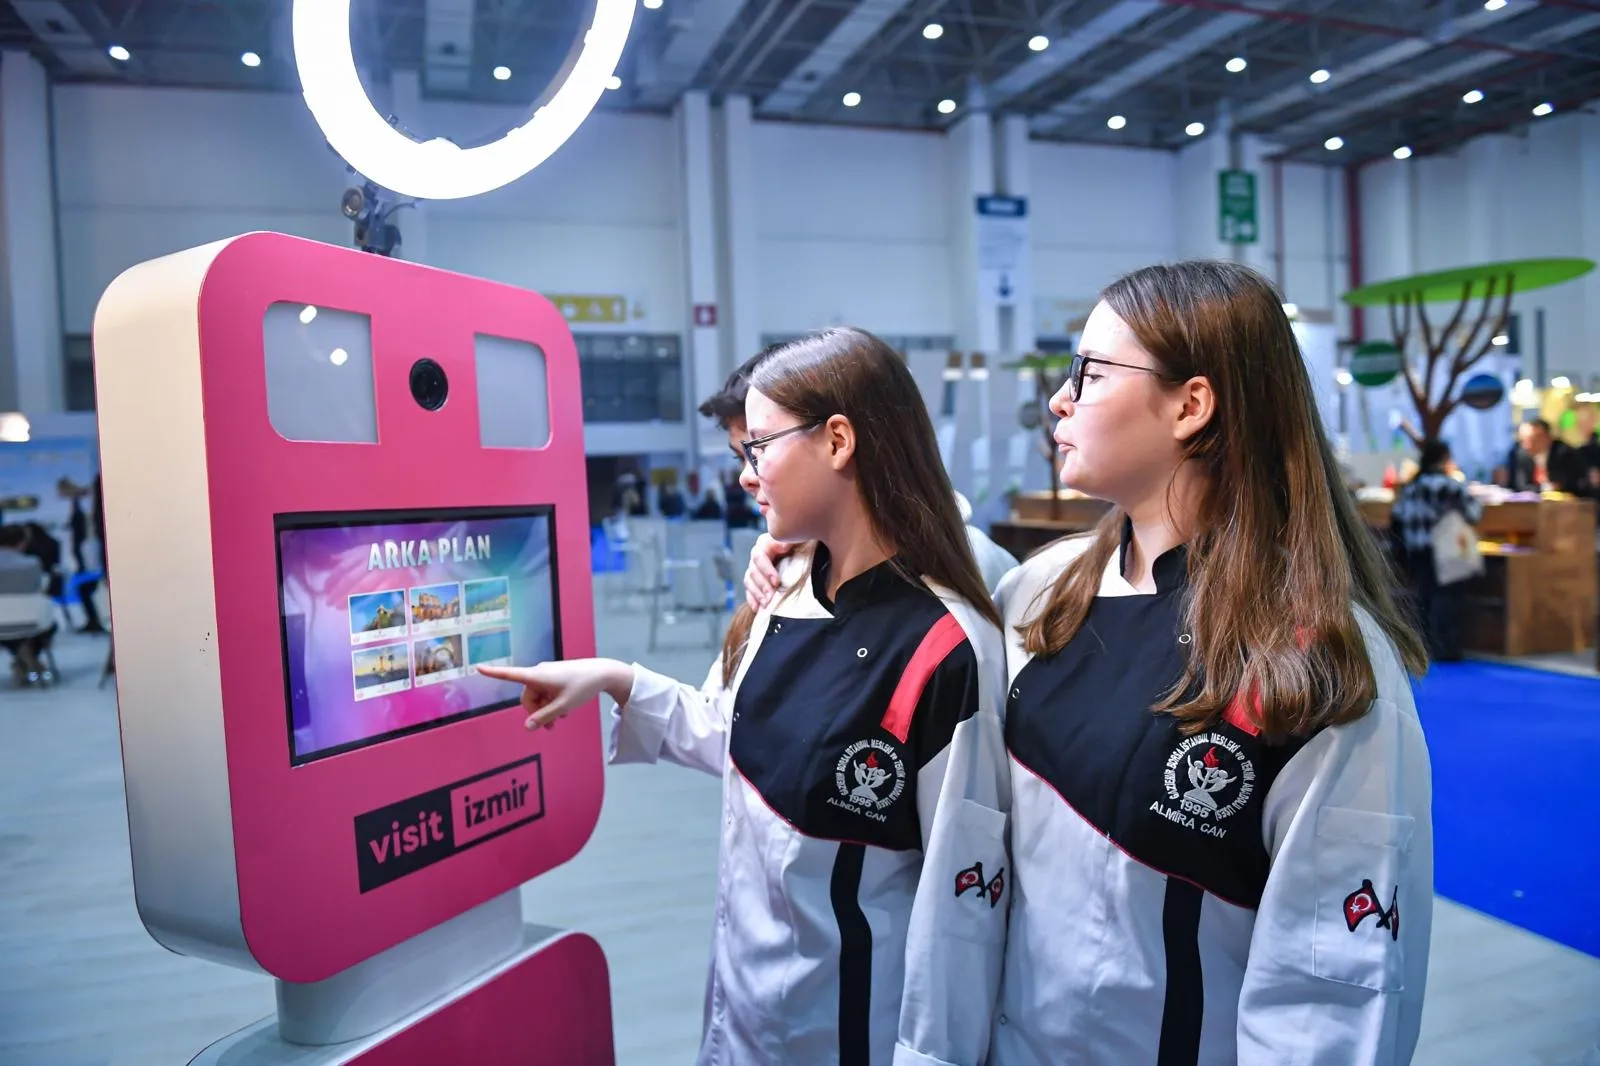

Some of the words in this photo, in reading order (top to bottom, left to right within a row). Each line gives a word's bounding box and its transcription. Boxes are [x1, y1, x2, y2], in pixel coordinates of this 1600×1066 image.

[368, 539, 432, 570] ARKA
[438, 535, 490, 563] PLAN
[1210, 732, 1241, 753] MESLEKİ
[369, 811, 444, 864] visit
[464, 778, 529, 828] izmir
[865, 811, 887, 822] CAN
[1200, 823, 1227, 838] CAN
